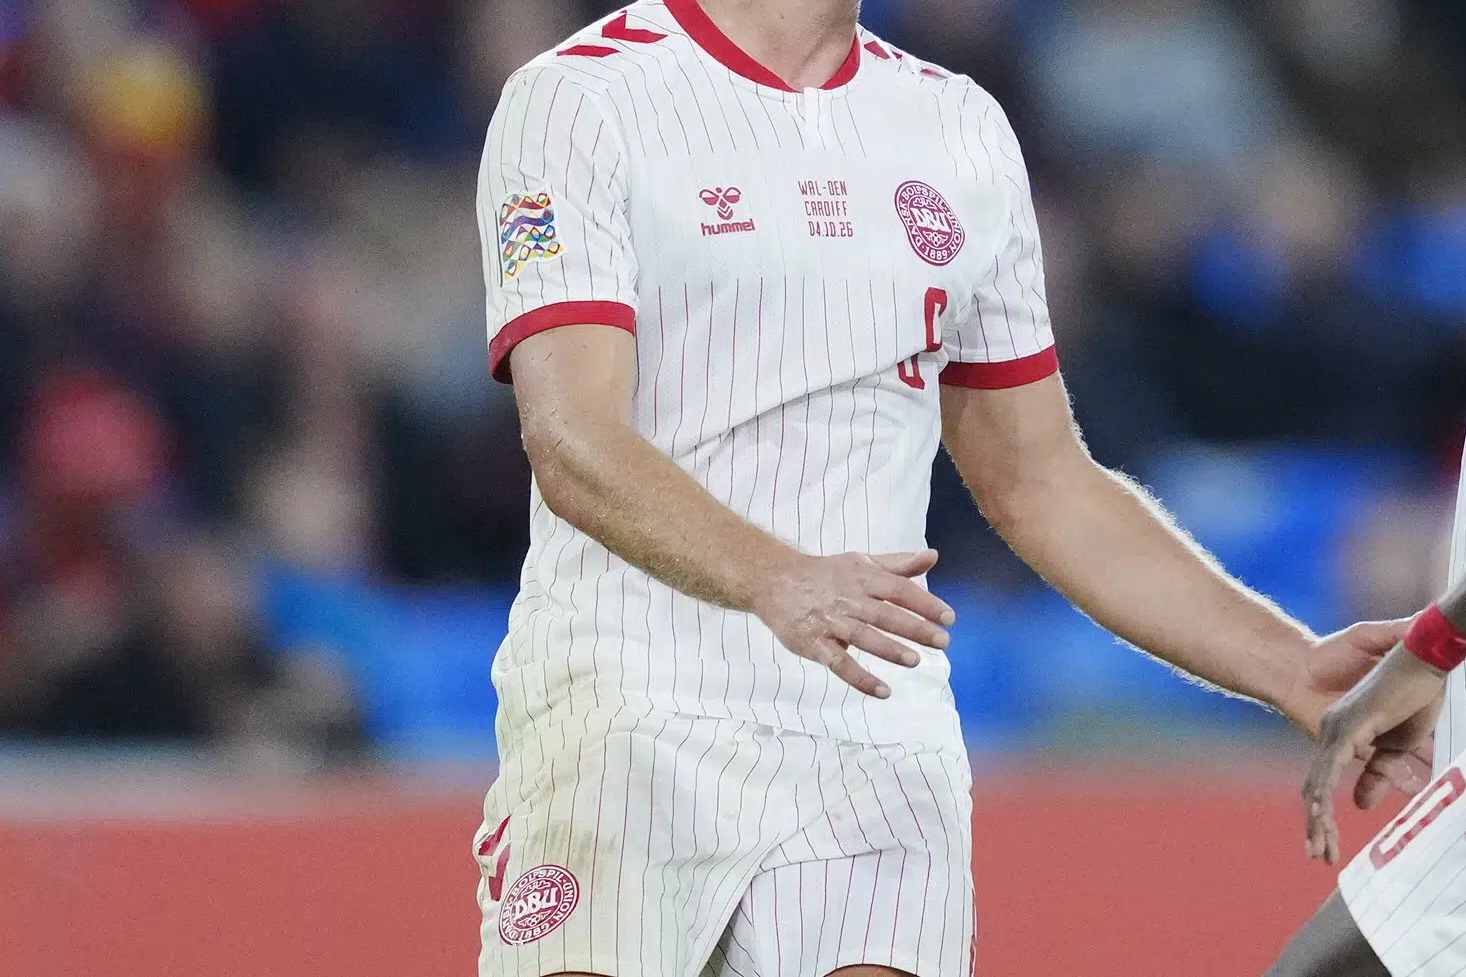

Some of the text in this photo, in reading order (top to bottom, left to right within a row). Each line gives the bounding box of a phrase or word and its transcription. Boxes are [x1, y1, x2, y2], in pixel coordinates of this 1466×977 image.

[798, 180, 848, 196] WAL-DEN
[804, 201, 847, 217] CARDIFF
[701, 218, 755, 236] hummel
[808, 221, 853, 237] 04.10.26
[924, 246, 948, 260] 1889
[513, 887, 558, 920] DBU
[553, 882, 573, 921] UNION
